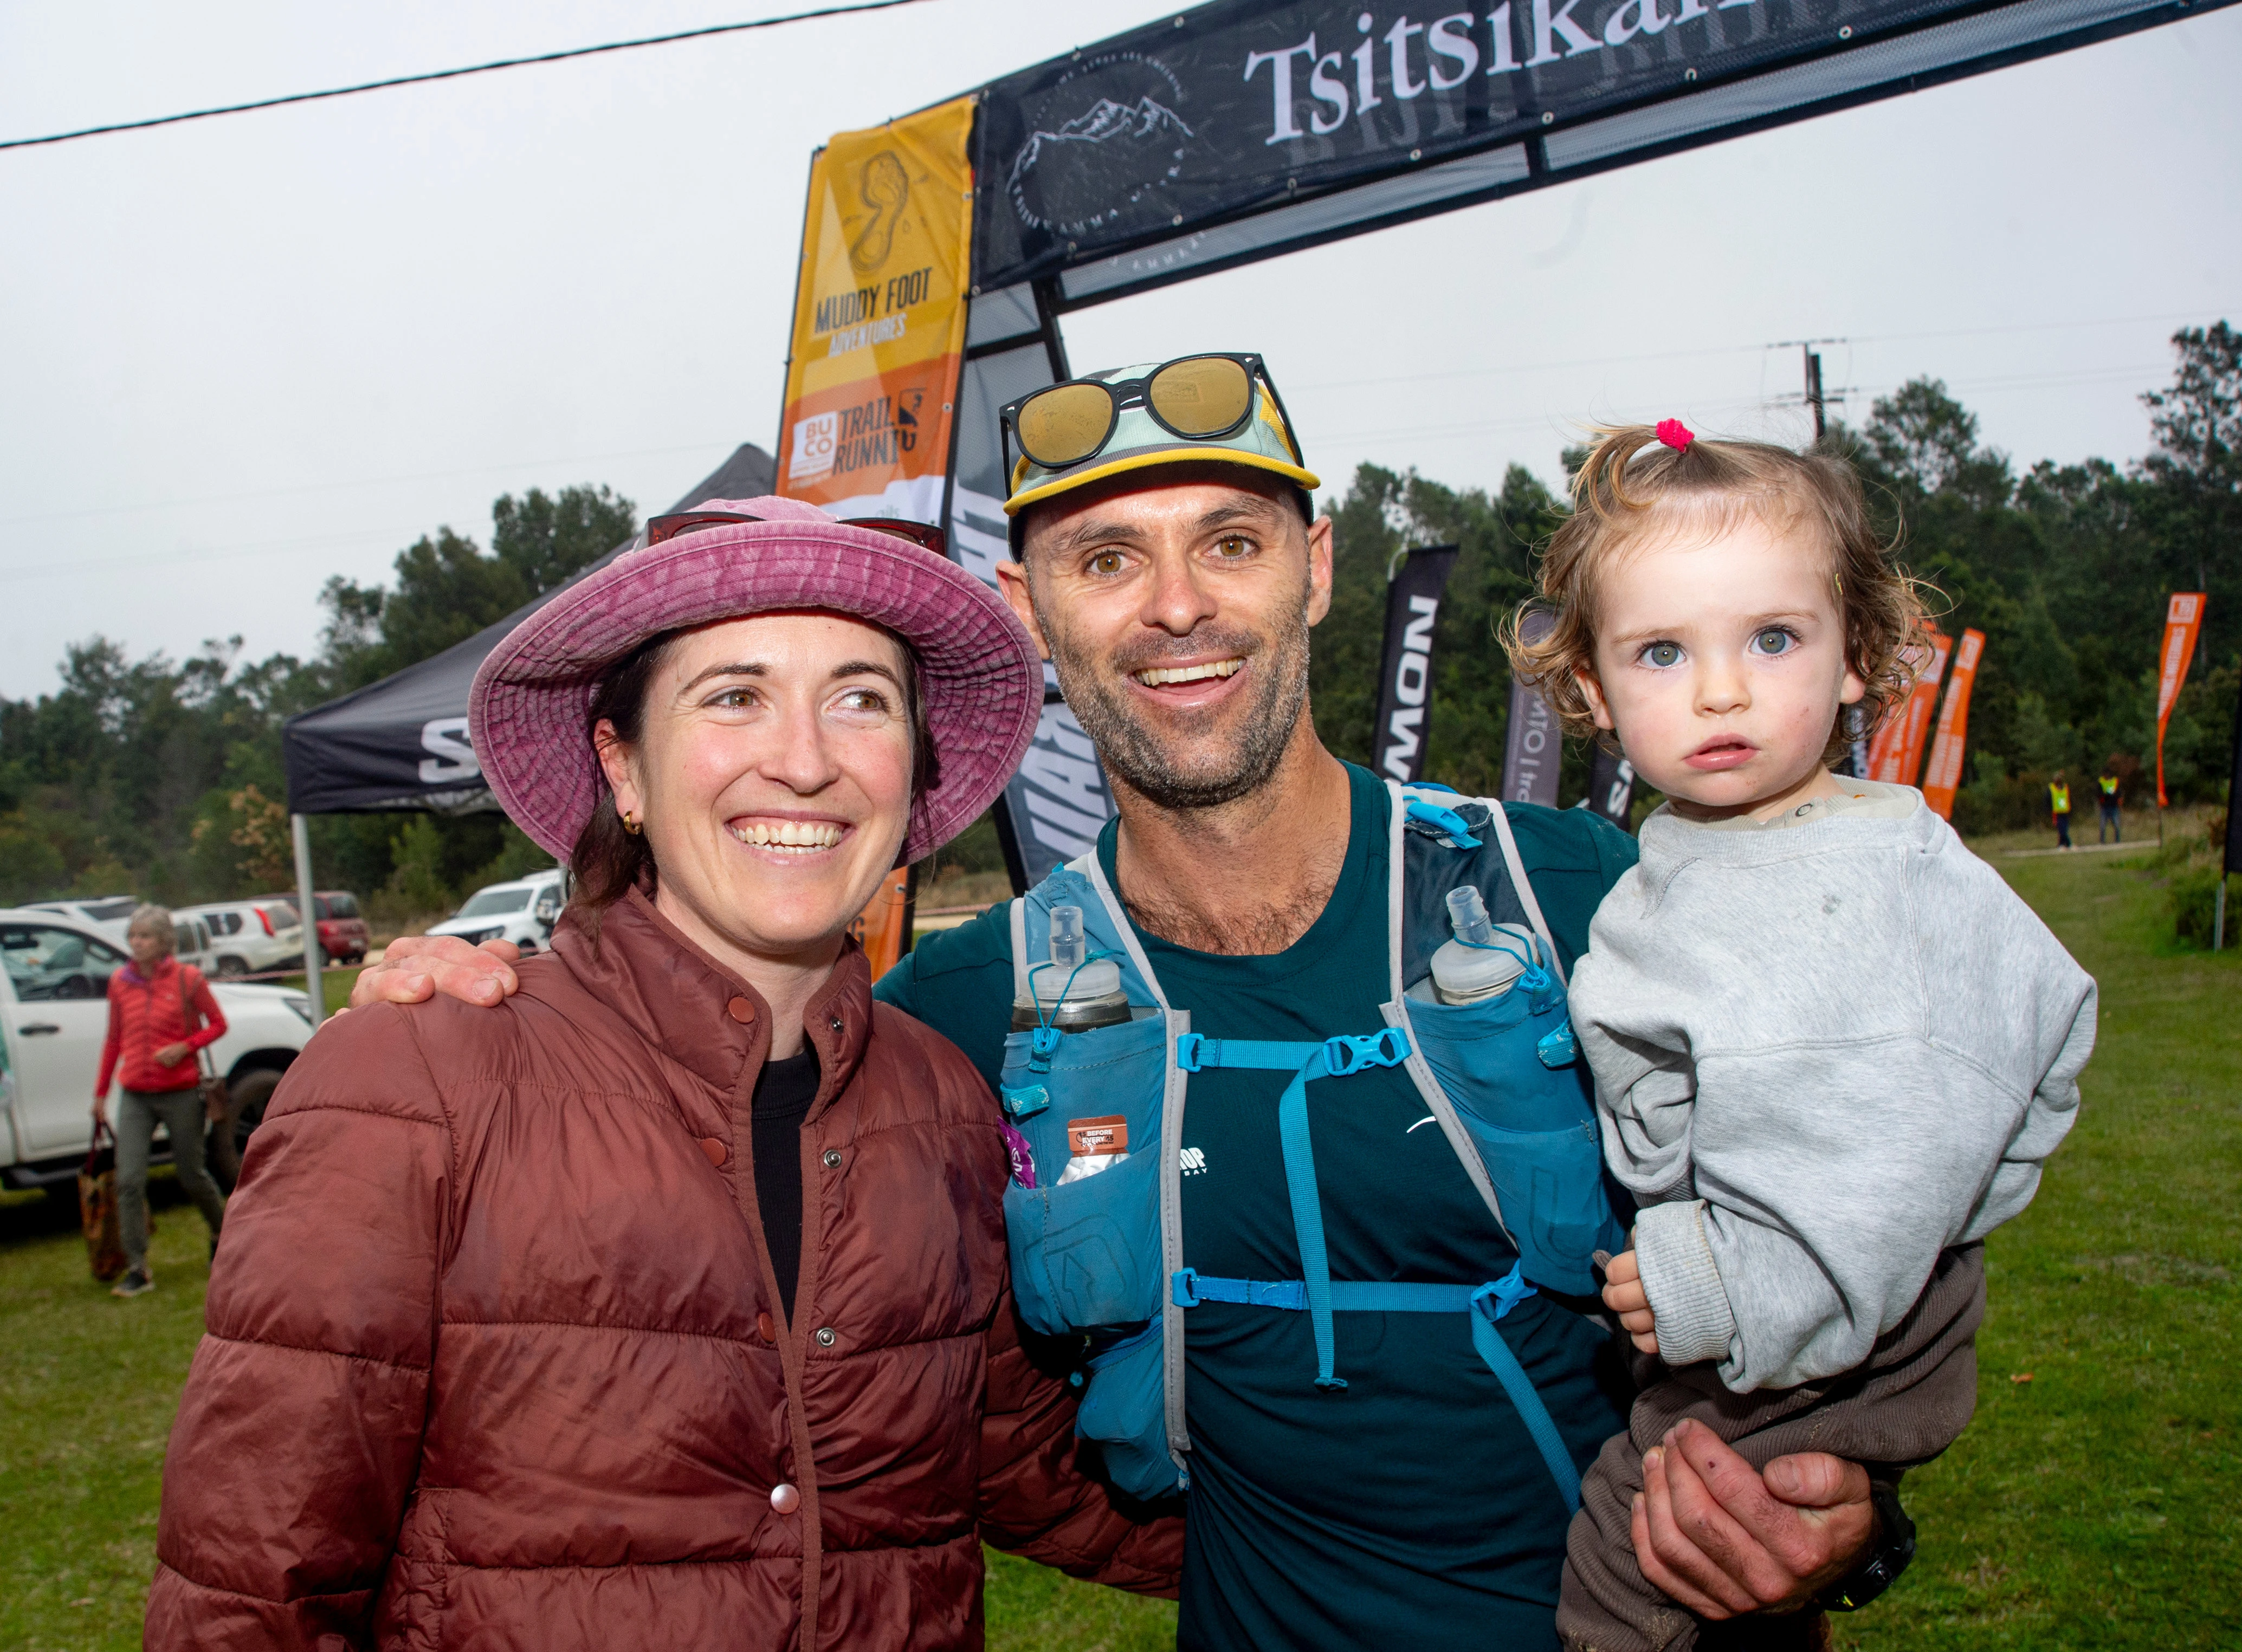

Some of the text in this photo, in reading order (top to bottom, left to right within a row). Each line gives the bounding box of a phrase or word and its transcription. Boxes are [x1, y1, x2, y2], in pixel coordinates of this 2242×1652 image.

[1244, 0, 1756, 145] Tsitsika
[815, 266, 933, 334] MUDDY FOOT
[828, 312, 908, 358] ADVENTURES
[840, 396, 894, 441] TRAIL
[1382, 594, 1438, 783] MON
[1082, 1136, 1105, 1144] EVERY
[1184, 1168, 1207, 1176] BAY
